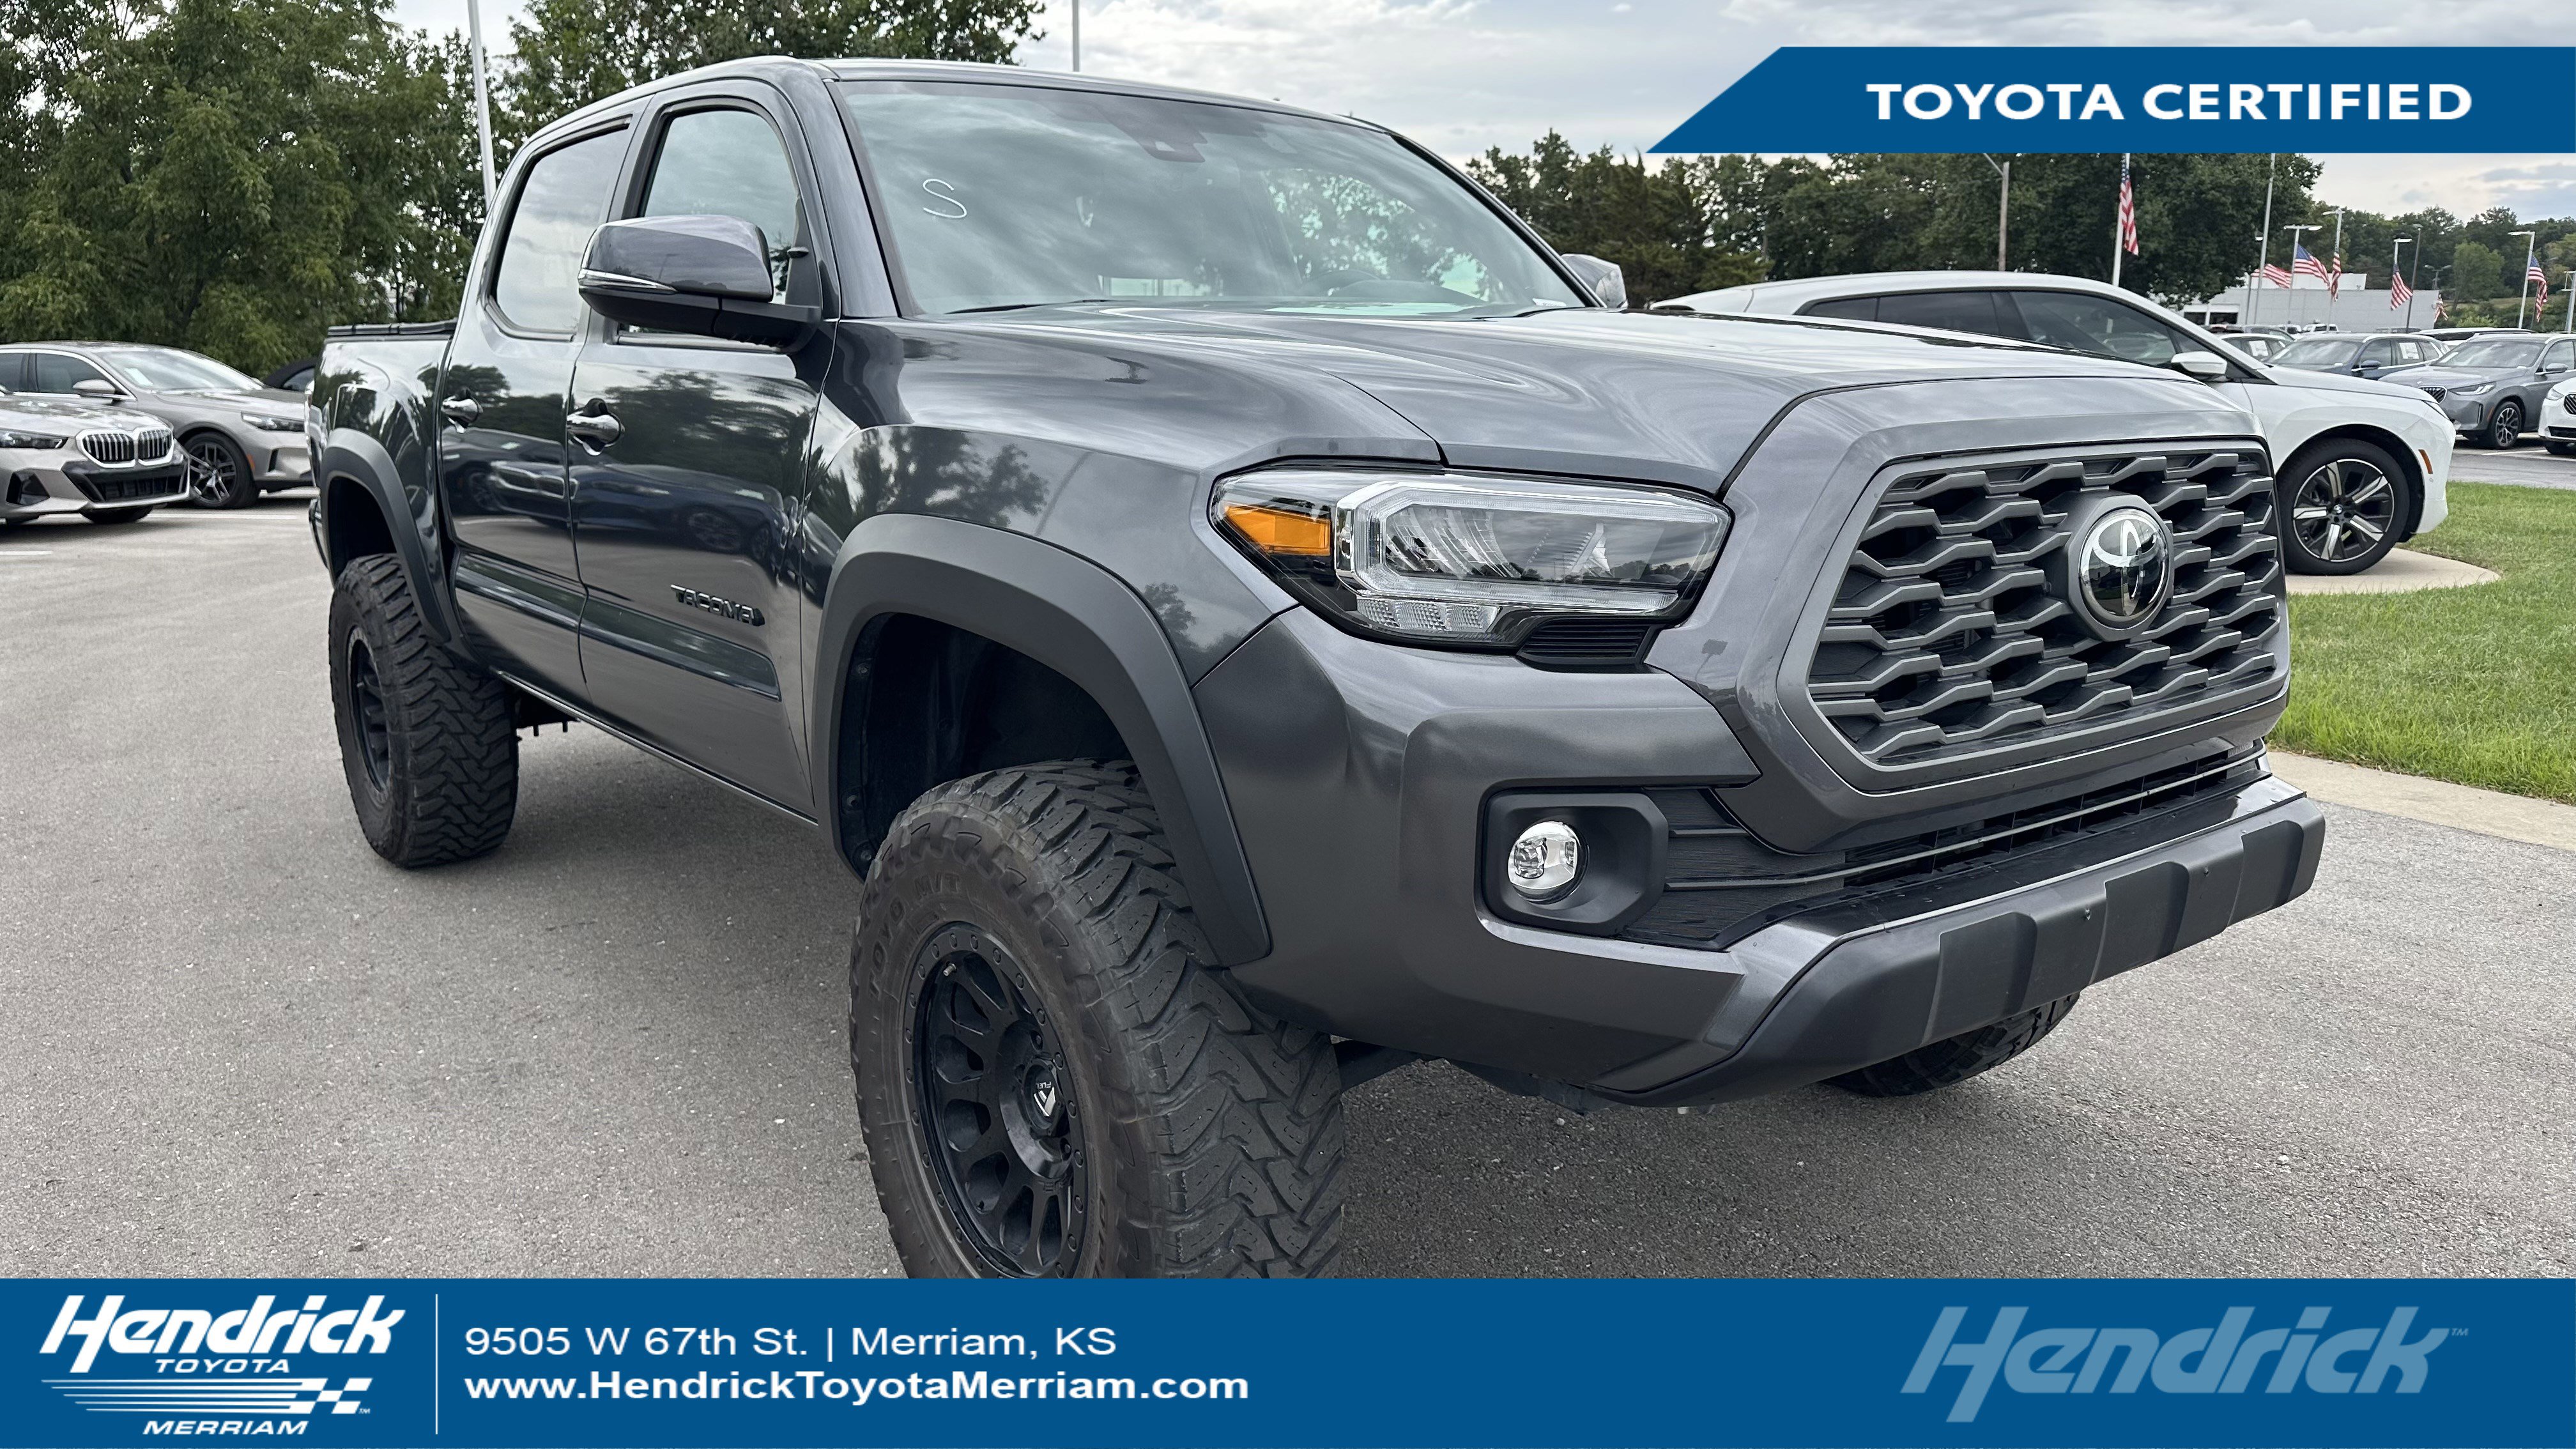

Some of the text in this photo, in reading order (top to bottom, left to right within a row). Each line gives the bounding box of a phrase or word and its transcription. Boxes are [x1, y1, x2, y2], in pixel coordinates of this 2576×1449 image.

[922, 178, 967, 218] S
[670, 583, 765, 627] TACOMA
[868, 896, 905, 1000] TOYO
